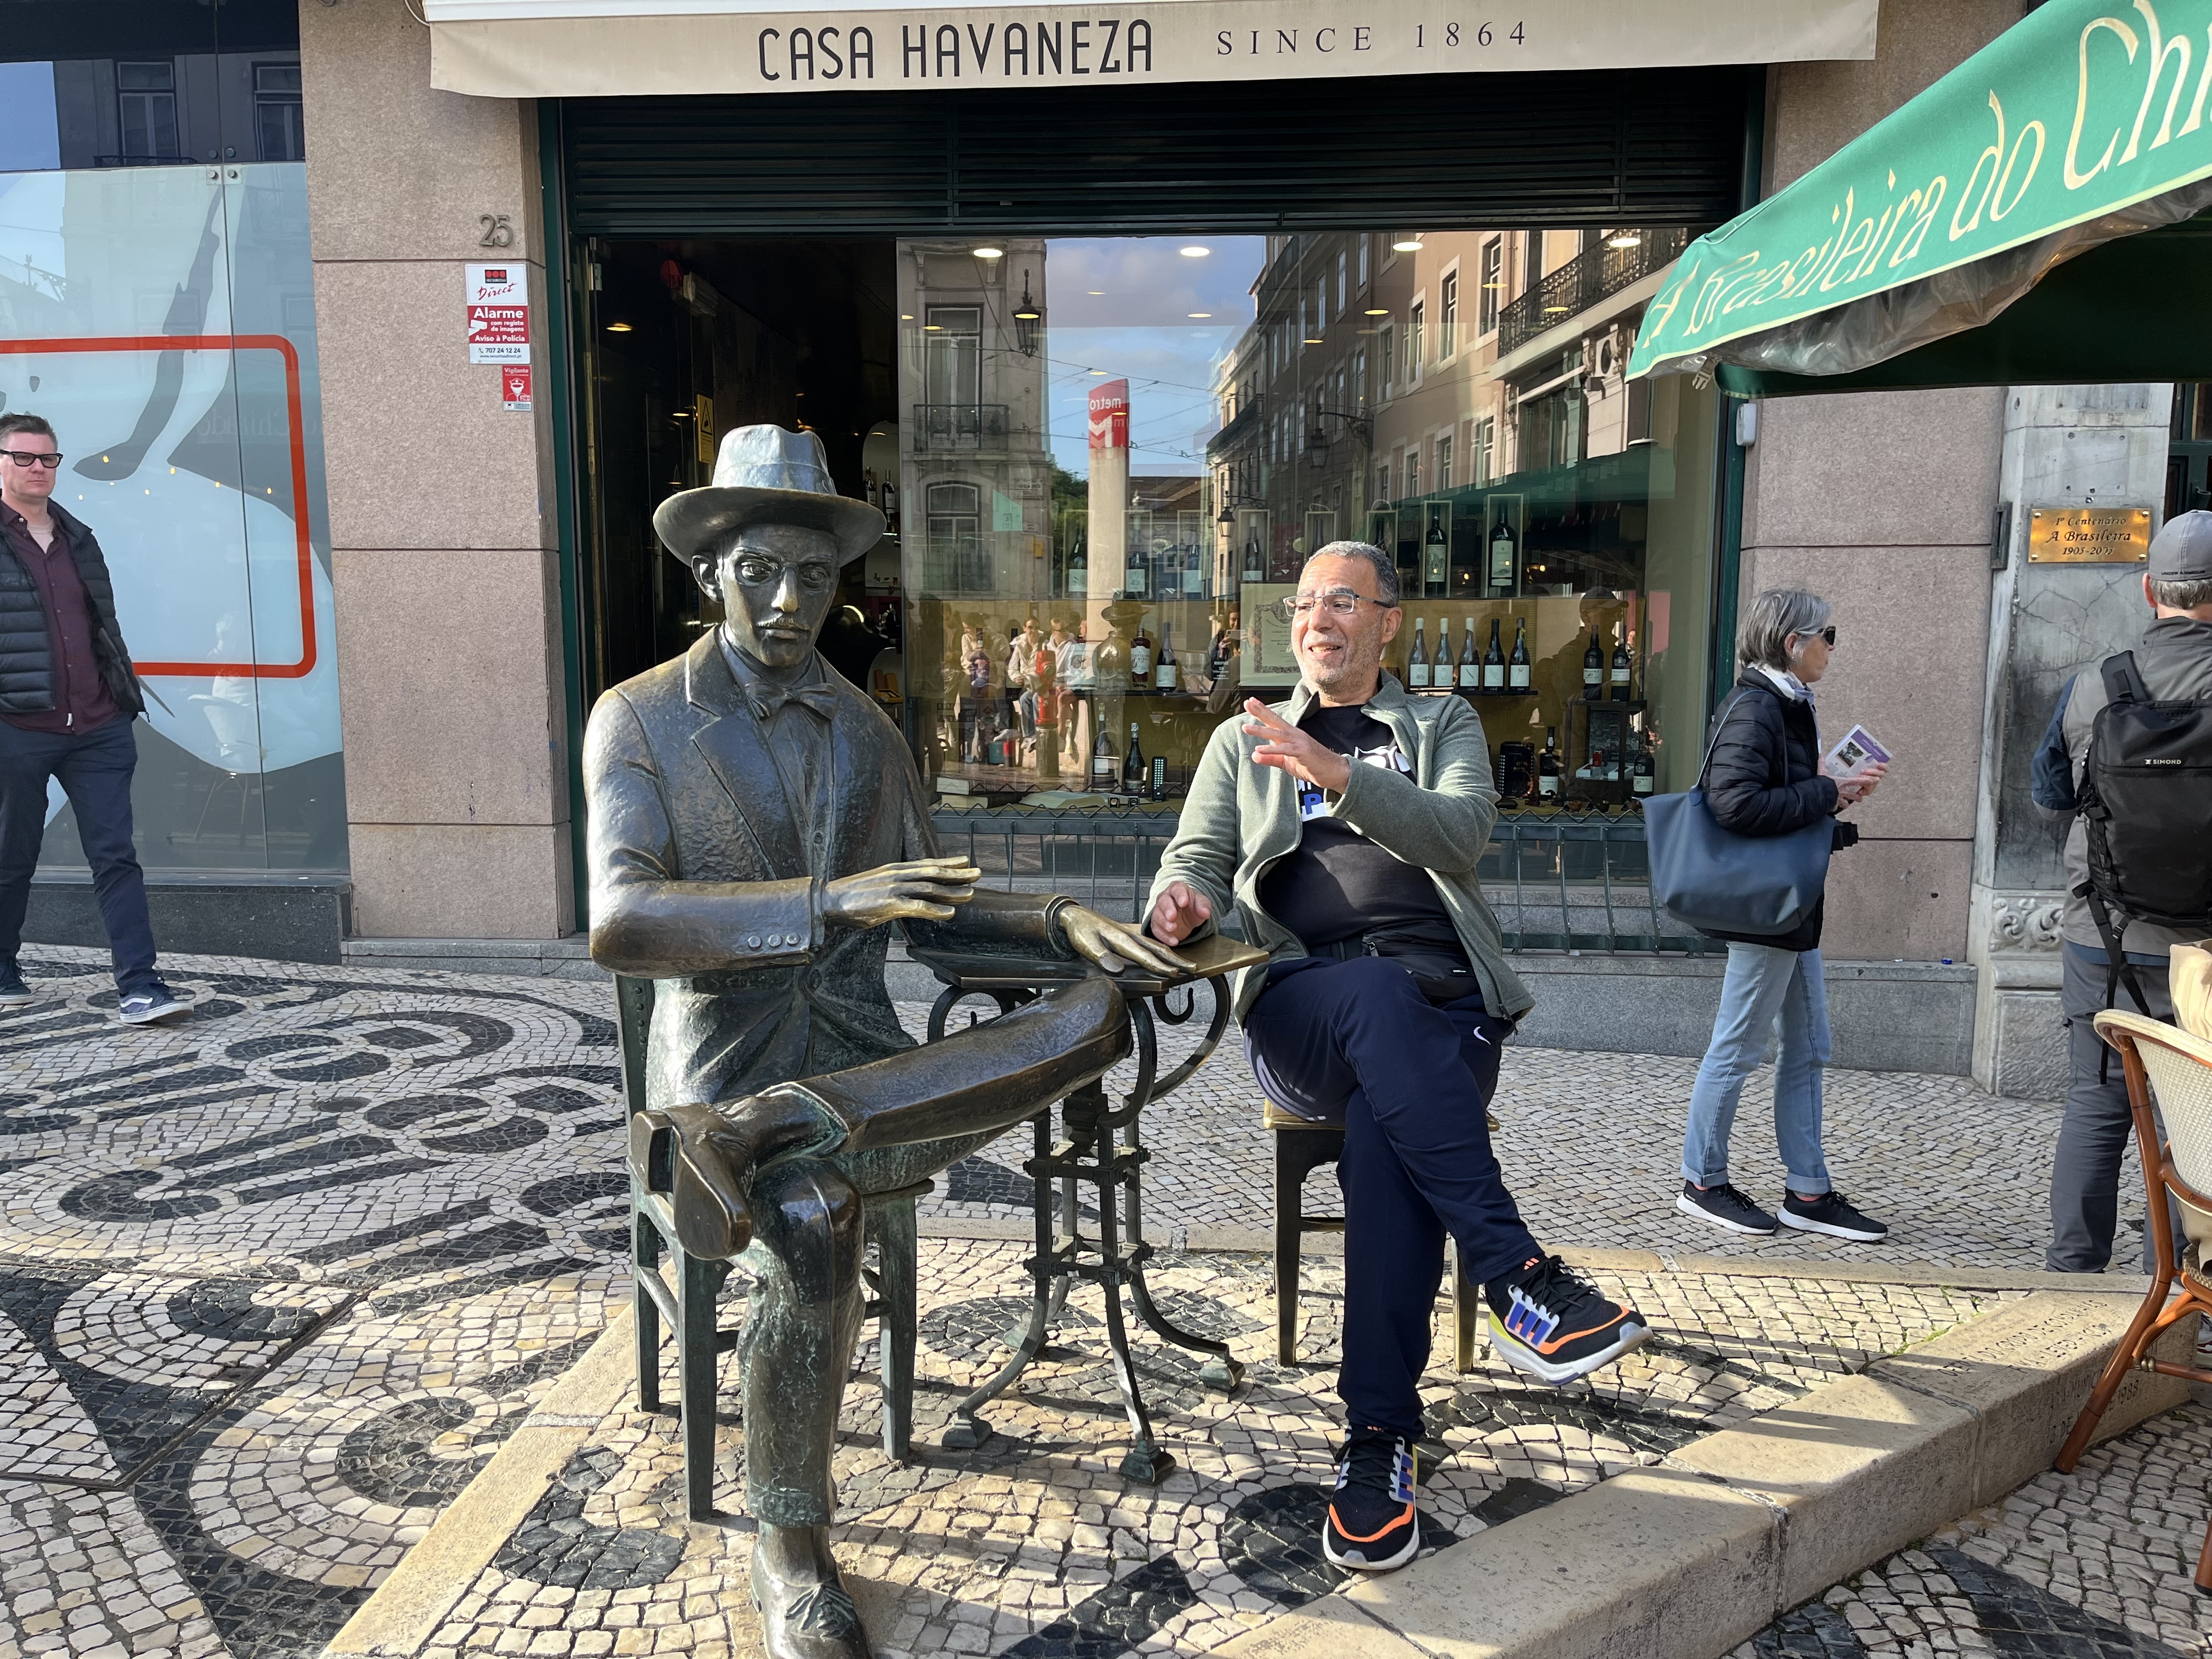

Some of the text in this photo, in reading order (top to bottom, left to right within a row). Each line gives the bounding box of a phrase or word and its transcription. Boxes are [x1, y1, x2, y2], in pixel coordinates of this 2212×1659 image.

[758, 19, 1526, 81] CASA HAVANEZA SINCE 1864
[1642, 0, 2212, 349] A Brasileira do Chi
[479, 213, 513, 247] 25
[476, 282, 518, 301] Direct
[473, 306, 524, 319] Alarme
[500, 325, 524, 334] imagens
[2067, 516, 2126, 527] Centenário
[2045, 529, 2131, 543] A Brasileira
[2062, 546, 2114, 555] 1905-2005
